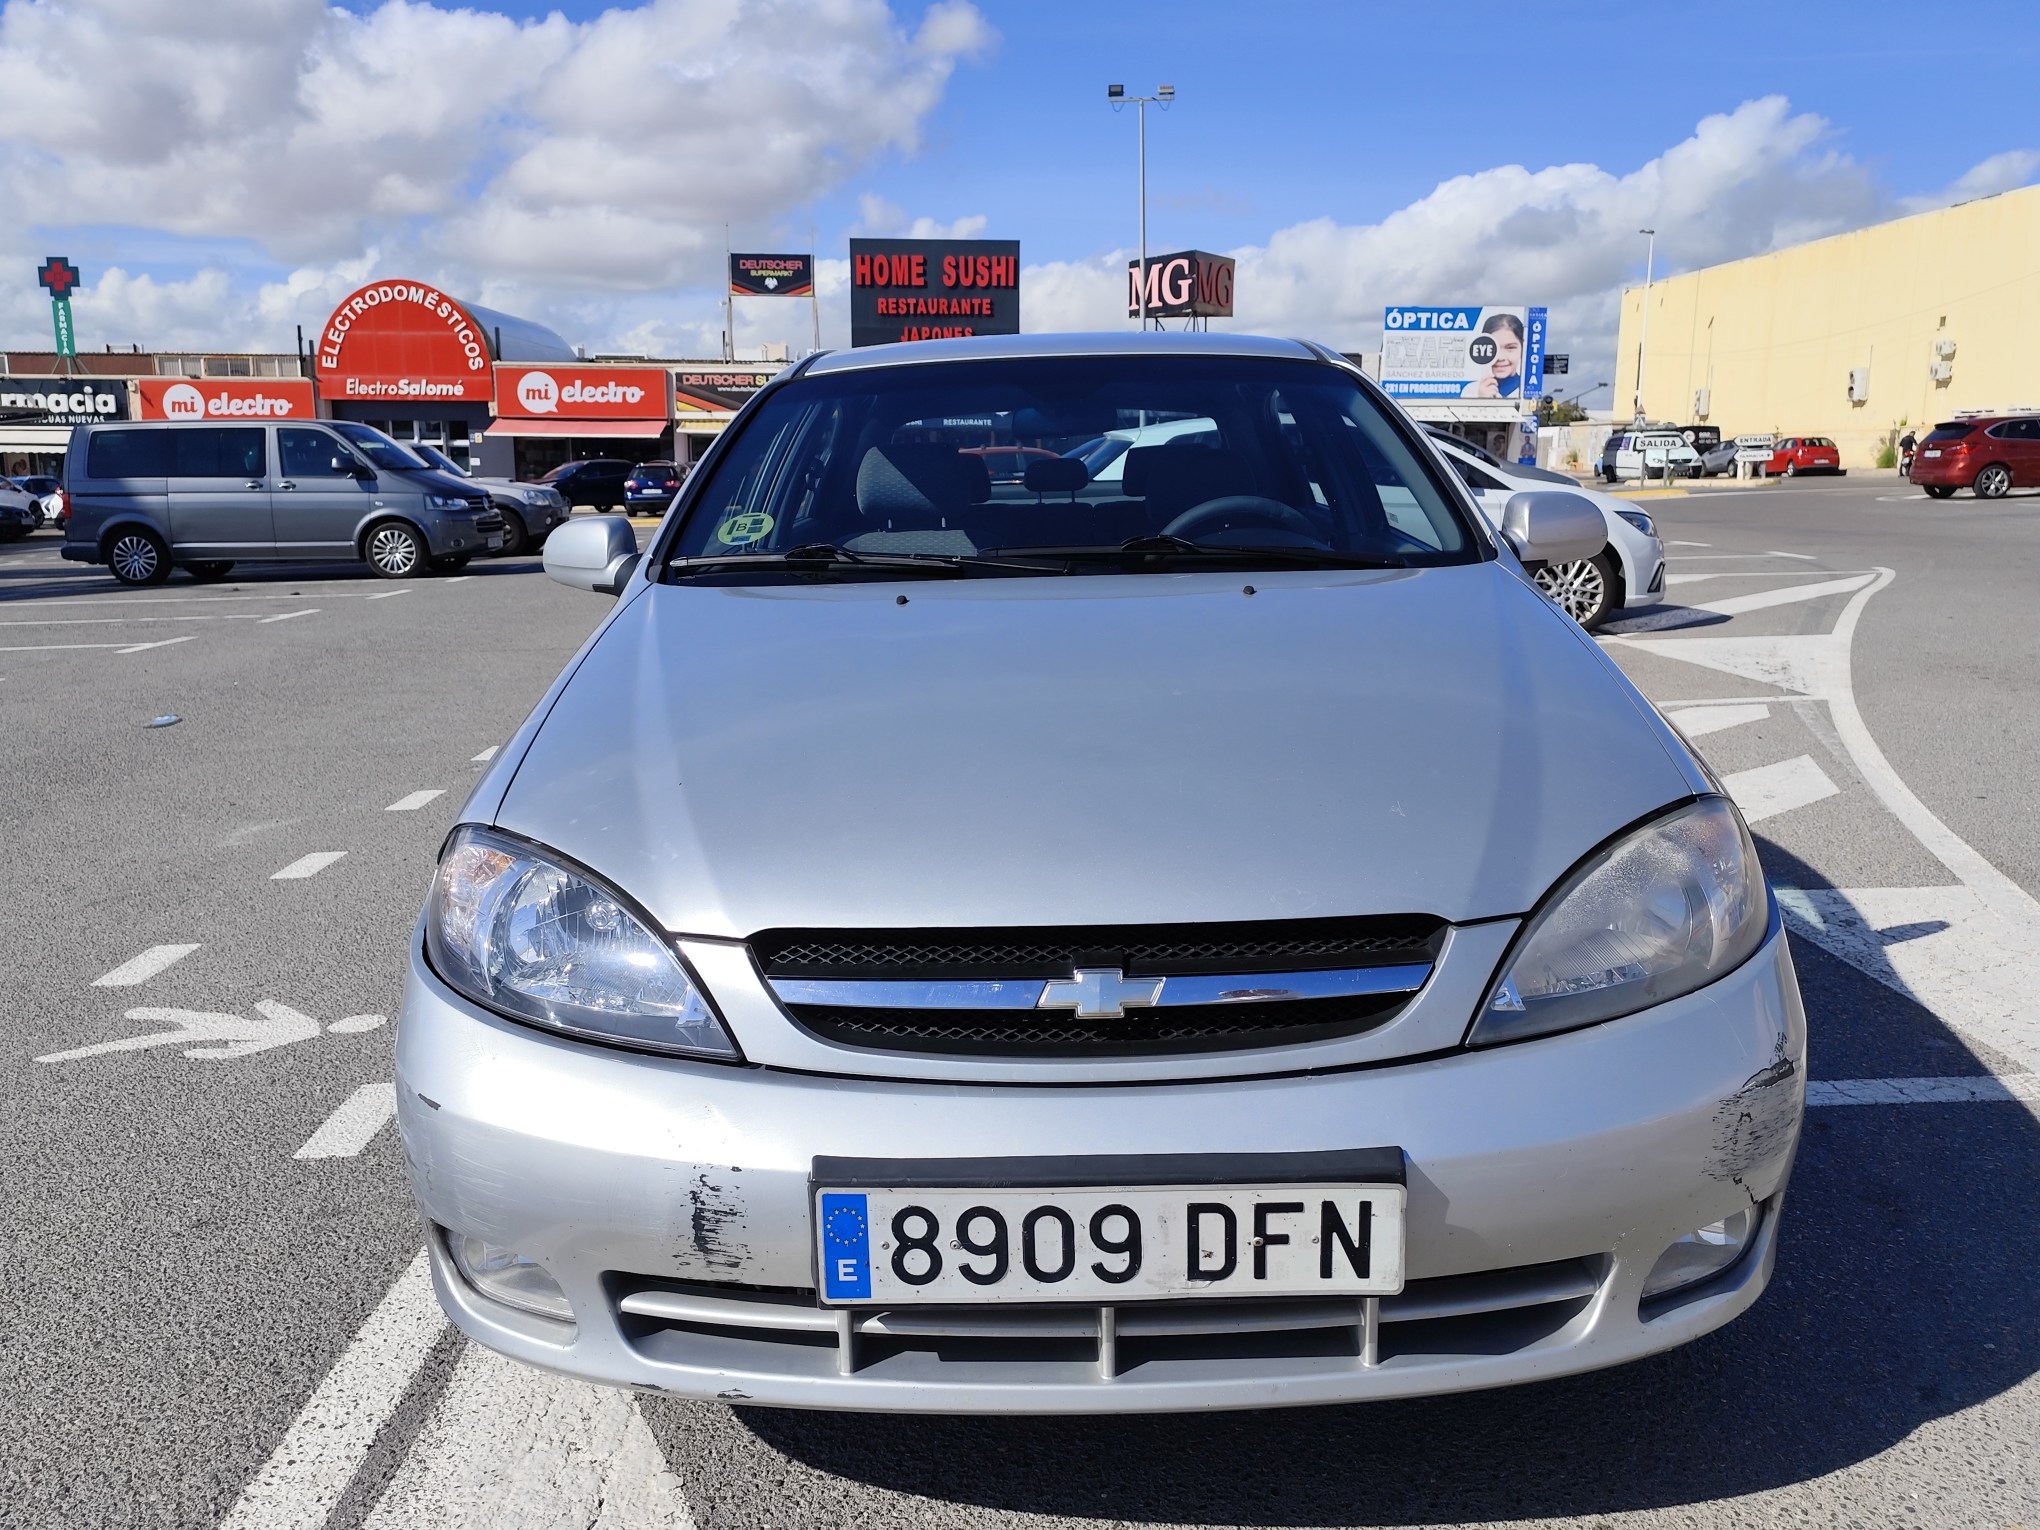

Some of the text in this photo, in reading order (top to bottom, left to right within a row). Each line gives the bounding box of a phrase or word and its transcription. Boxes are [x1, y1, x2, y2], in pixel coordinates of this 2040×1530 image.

[739, 260, 803, 270] DEUTSCHER
[855, 254, 1015, 287] HOME SUSHI
[1128, 258, 1193, 311] MG
[1196, 260, 1233, 308] MG
[877, 298, 991, 315] RESTAURANTE
[58, 302, 70, 355] FARMACIA
[321, 285, 484, 371] ELECTRODOMÉSTICOS
[1386, 308, 1470, 329] ÓPTICA
[900, 326, 973, 342] JAPONES
[1472, 344, 1494, 357] EYE
[346, 378, 464, 396] ElectroSalomé
[683, 375, 774, 385] DEUTSCHER SU
[1400, 384, 1409, 393] EN
[526, 380, 645, 403] mi electro
[172, 392, 293, 416] mi electro
[69, 415, 105, 424] NUEVAS
[736, 523, 747, 531] B
[890, 1200, 1372, 1286] 8909 DFN
[838, 1260, 857, 1281] E
